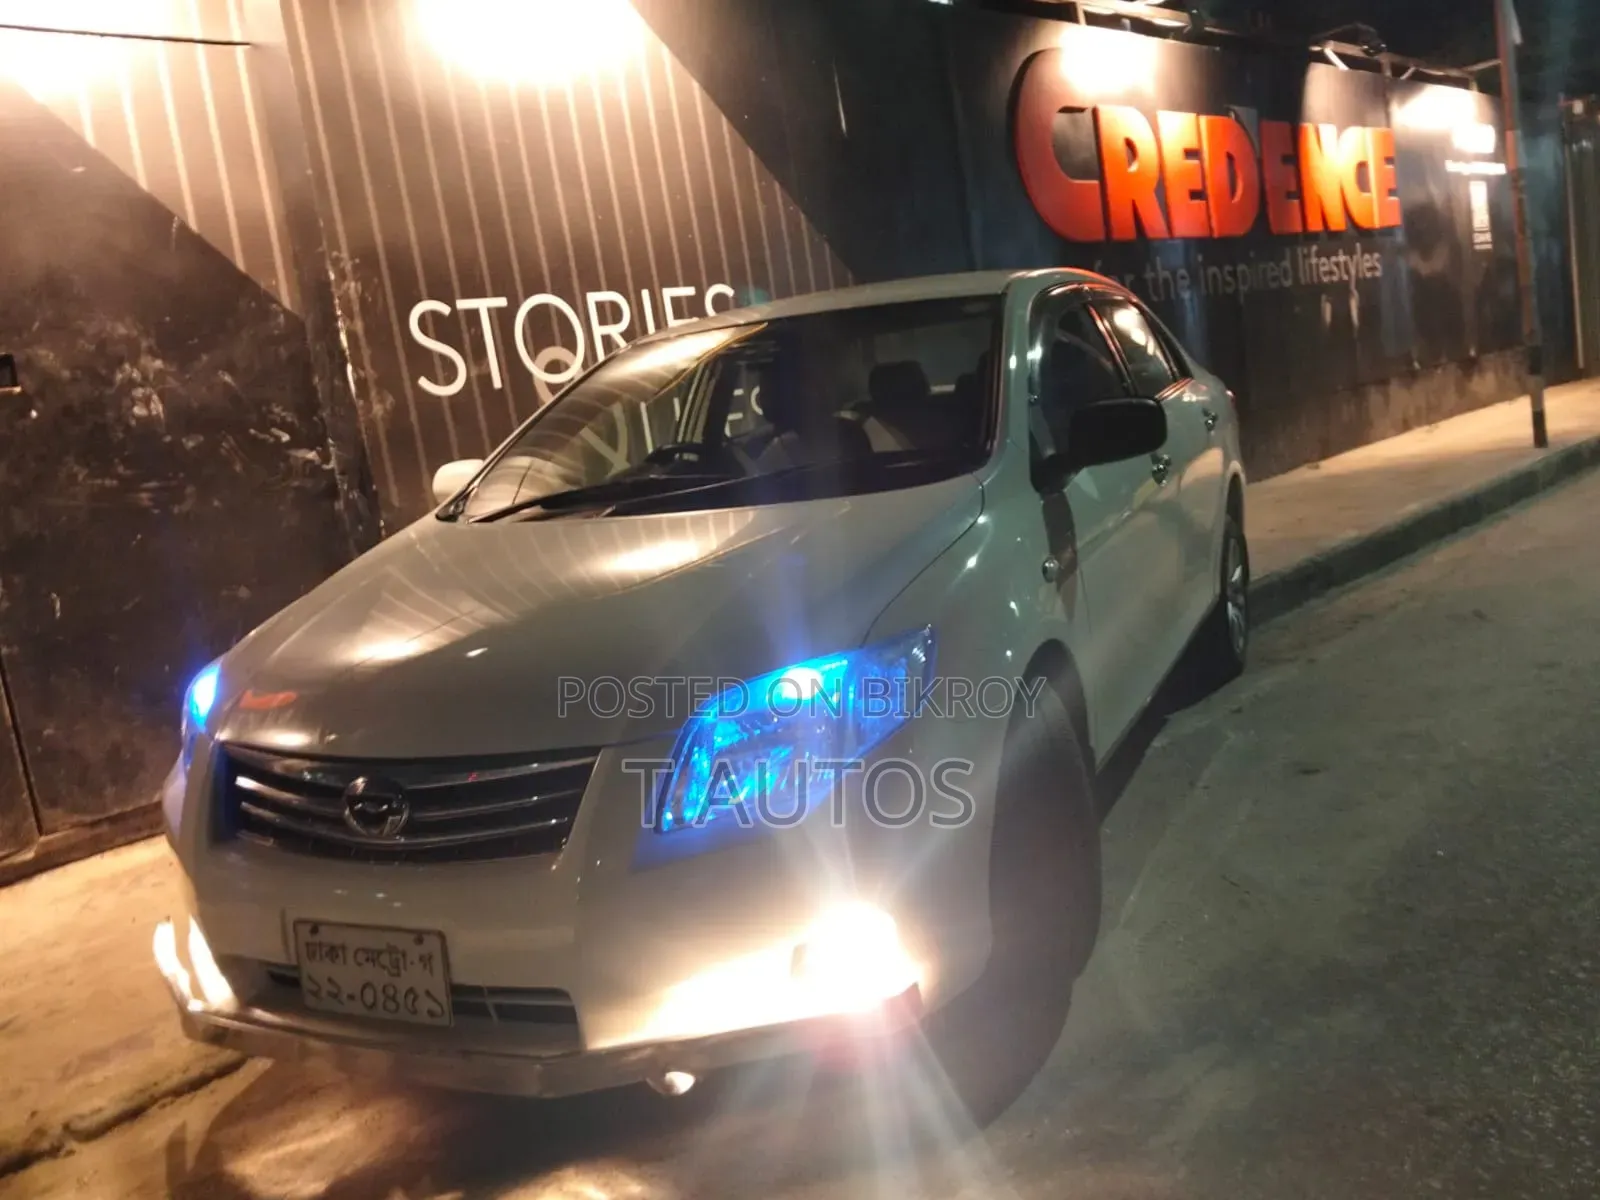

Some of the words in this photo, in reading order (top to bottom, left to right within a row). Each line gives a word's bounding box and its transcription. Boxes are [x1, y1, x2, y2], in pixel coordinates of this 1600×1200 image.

[1012, 47, 1402, 242] CREDENCE
[1144, 256, 1191, 302] the
[1198, 251, 1293, 304] inspired
[1299, 242, 1383, 289] lifestyles
